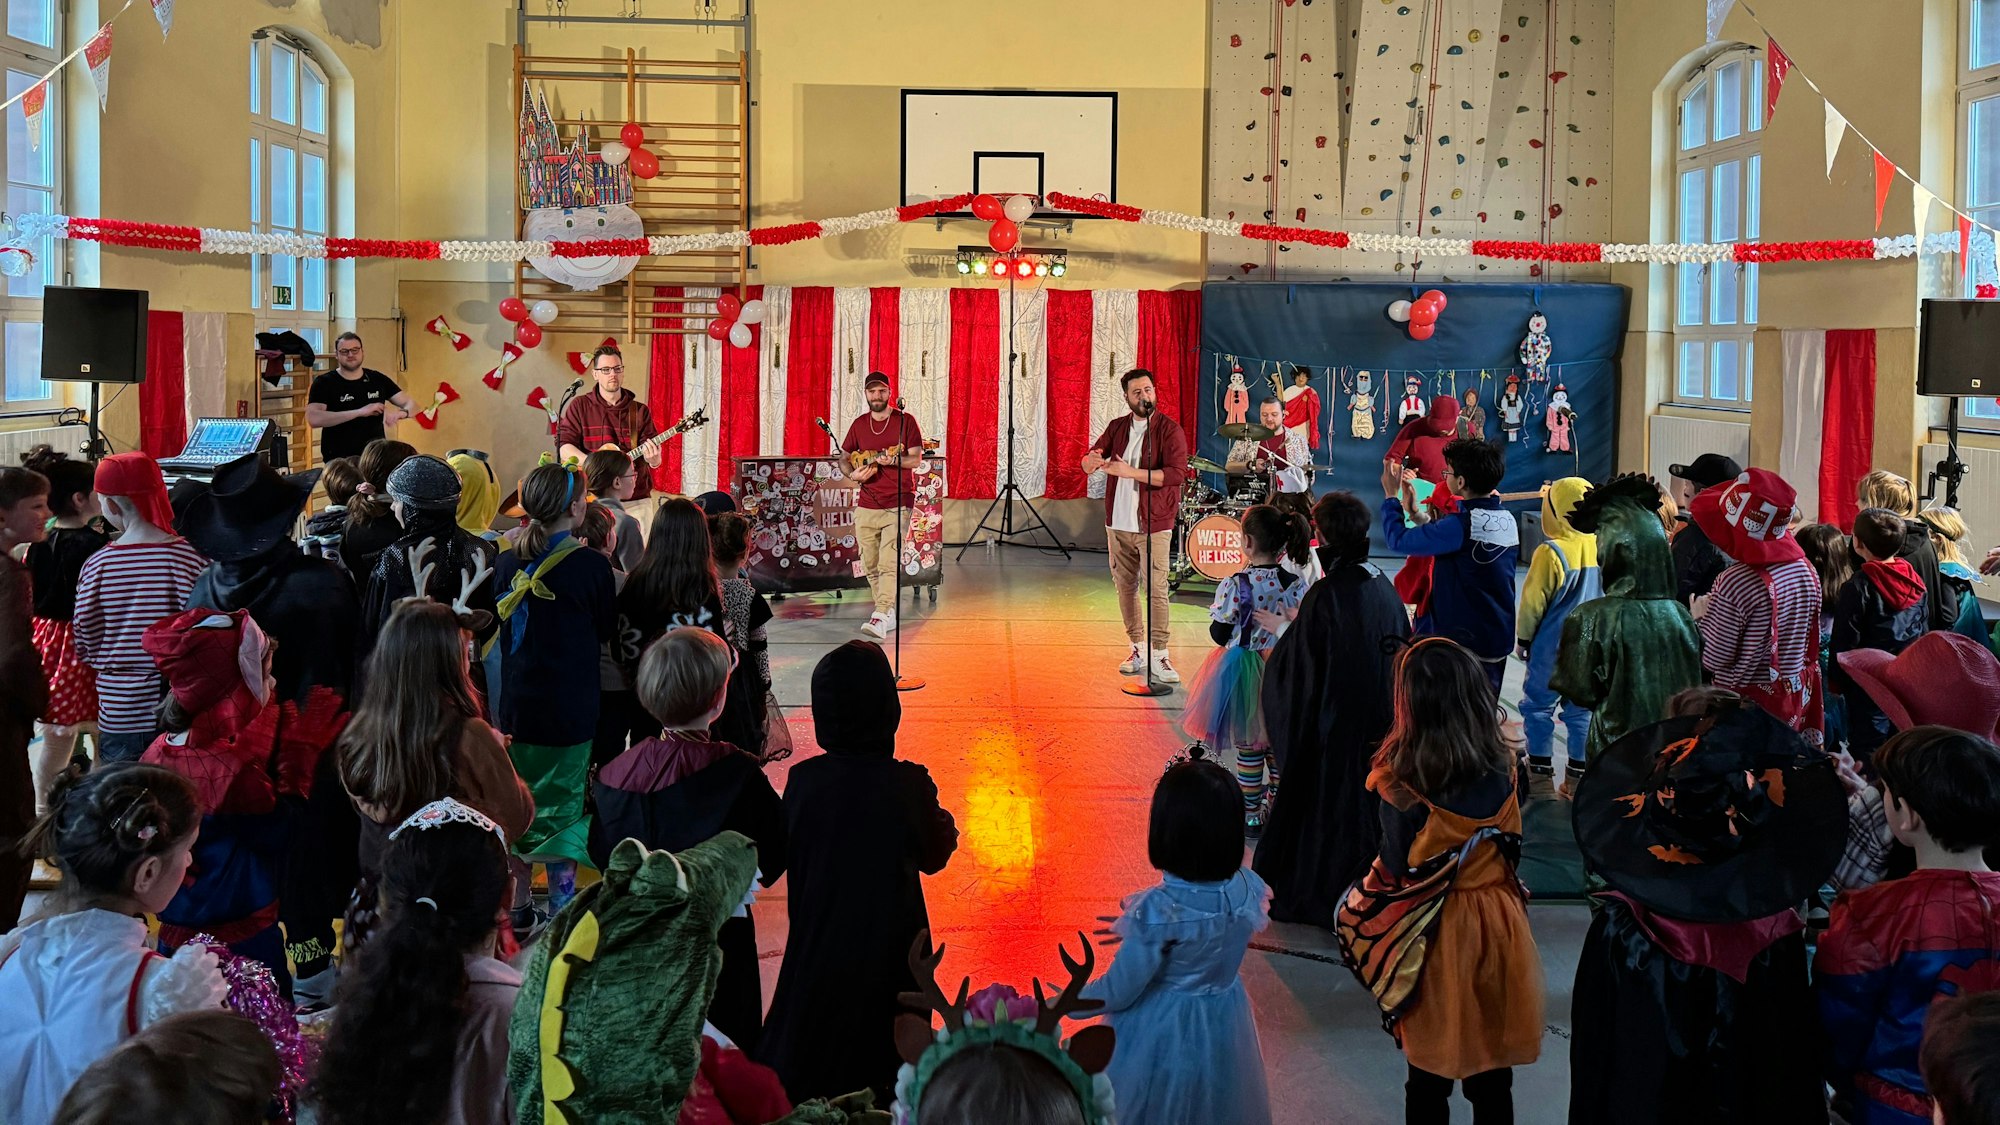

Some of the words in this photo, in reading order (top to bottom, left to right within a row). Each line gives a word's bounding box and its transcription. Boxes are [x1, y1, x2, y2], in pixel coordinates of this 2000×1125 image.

[822, 512, 839, 529] HE
[839, 511, 856, 528] LO
[1198, 550, 1213, 564] HE
[1214, 550, 1241, 564] LOSS
[1787, 714, 1799, 728] ölle
